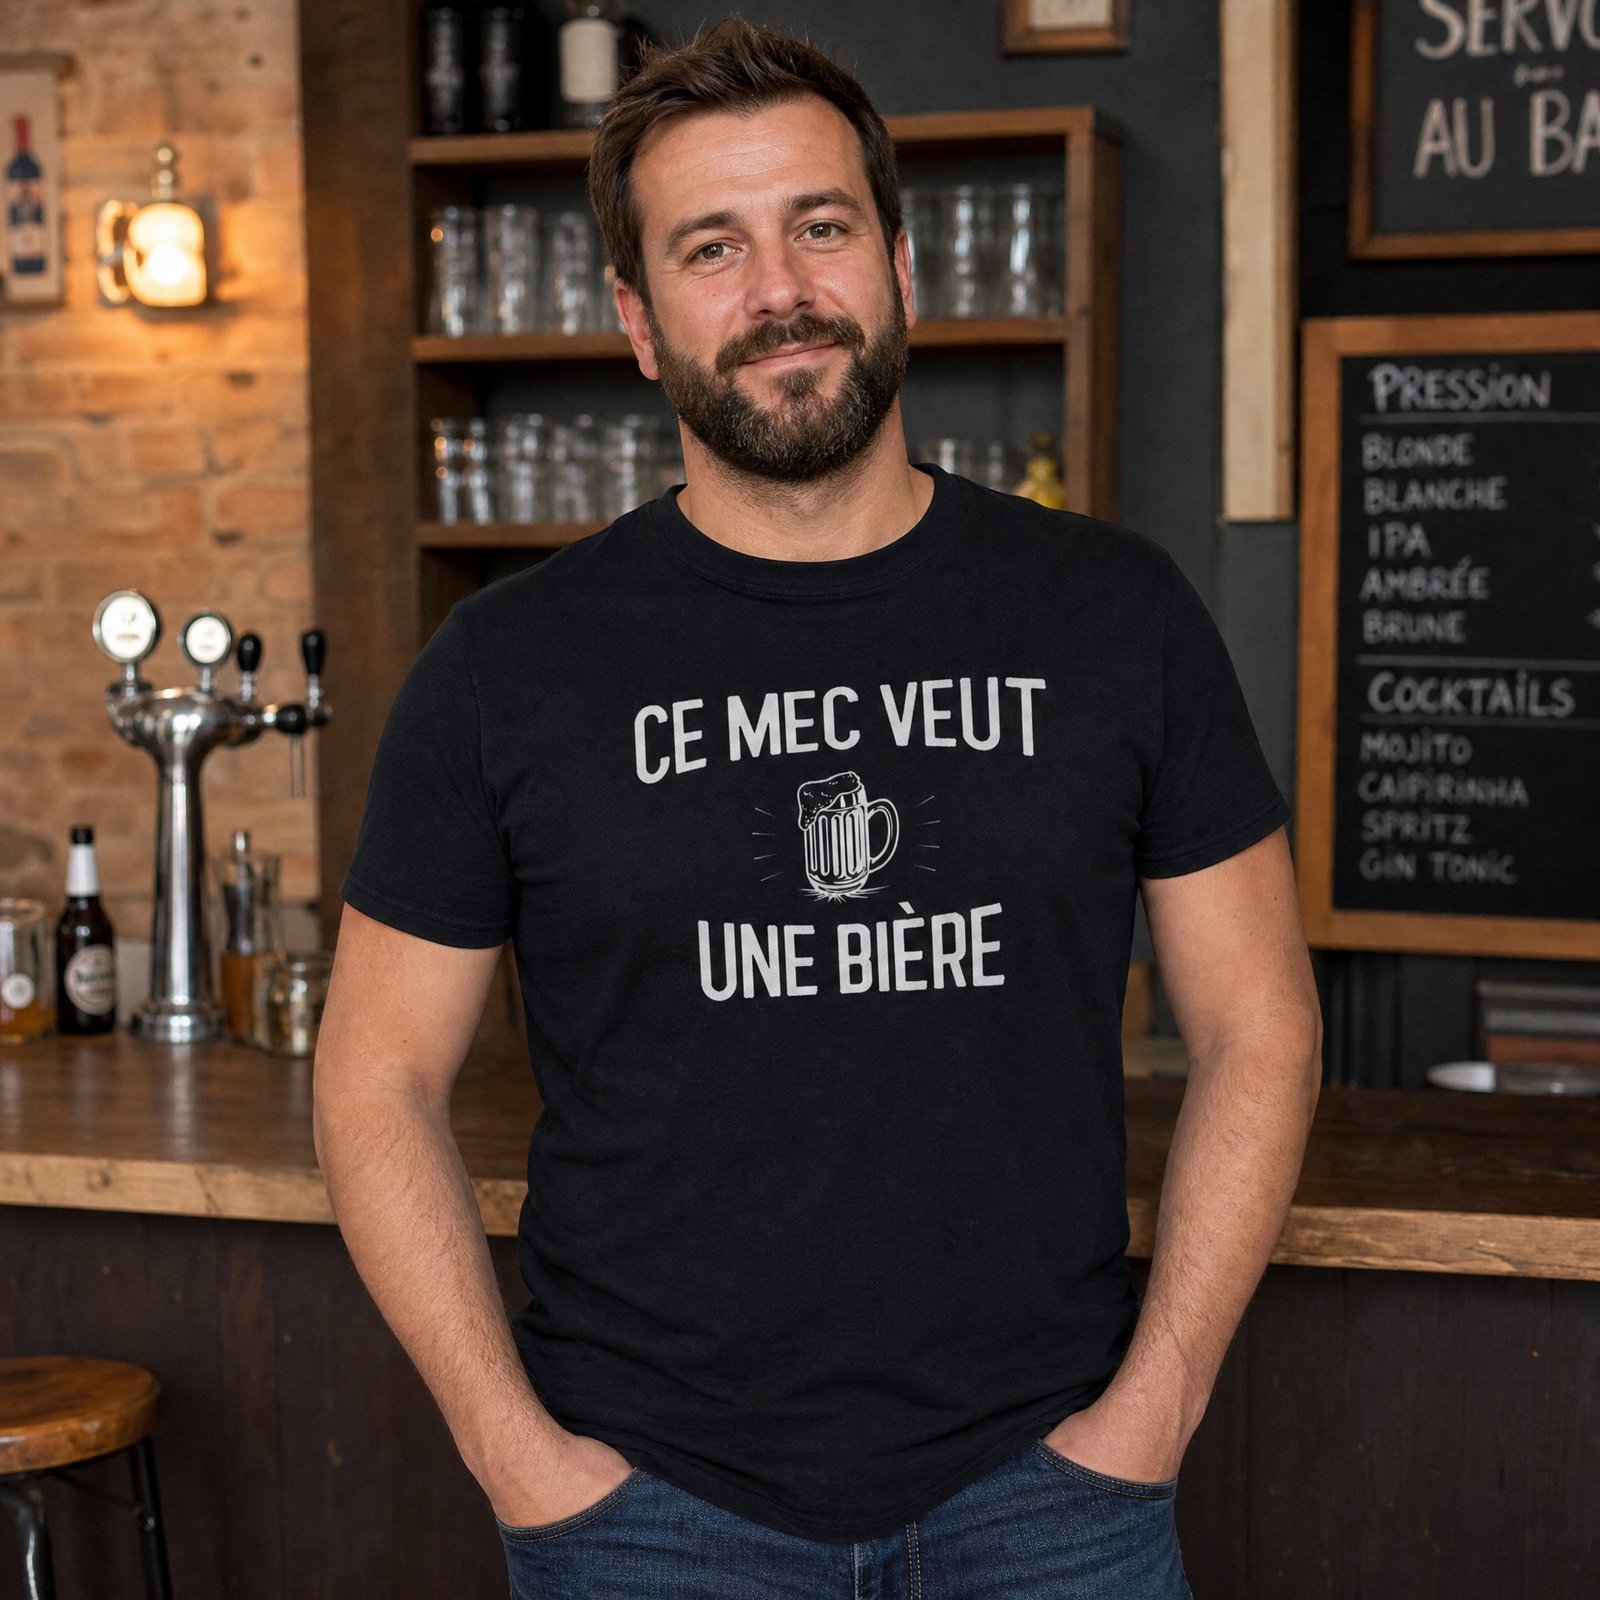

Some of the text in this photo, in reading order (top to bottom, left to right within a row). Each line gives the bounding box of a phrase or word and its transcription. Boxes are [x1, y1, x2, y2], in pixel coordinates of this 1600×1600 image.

[1413, 97, 1494, 178] AU
[1362, 432, 1472, 471] BLONDE
[1363, 476, 1506, 515] BLANCHE
[1368, 521, 1431, 558] IPA
[1360, 556, 1488, 601] AMBRÉE
[1362, 608, 1465, 644] BRUNE
[634, 677, 1047, 785] CE MEC VEUT
[698, 901, 1006, 1002] UNE BIÈRE
